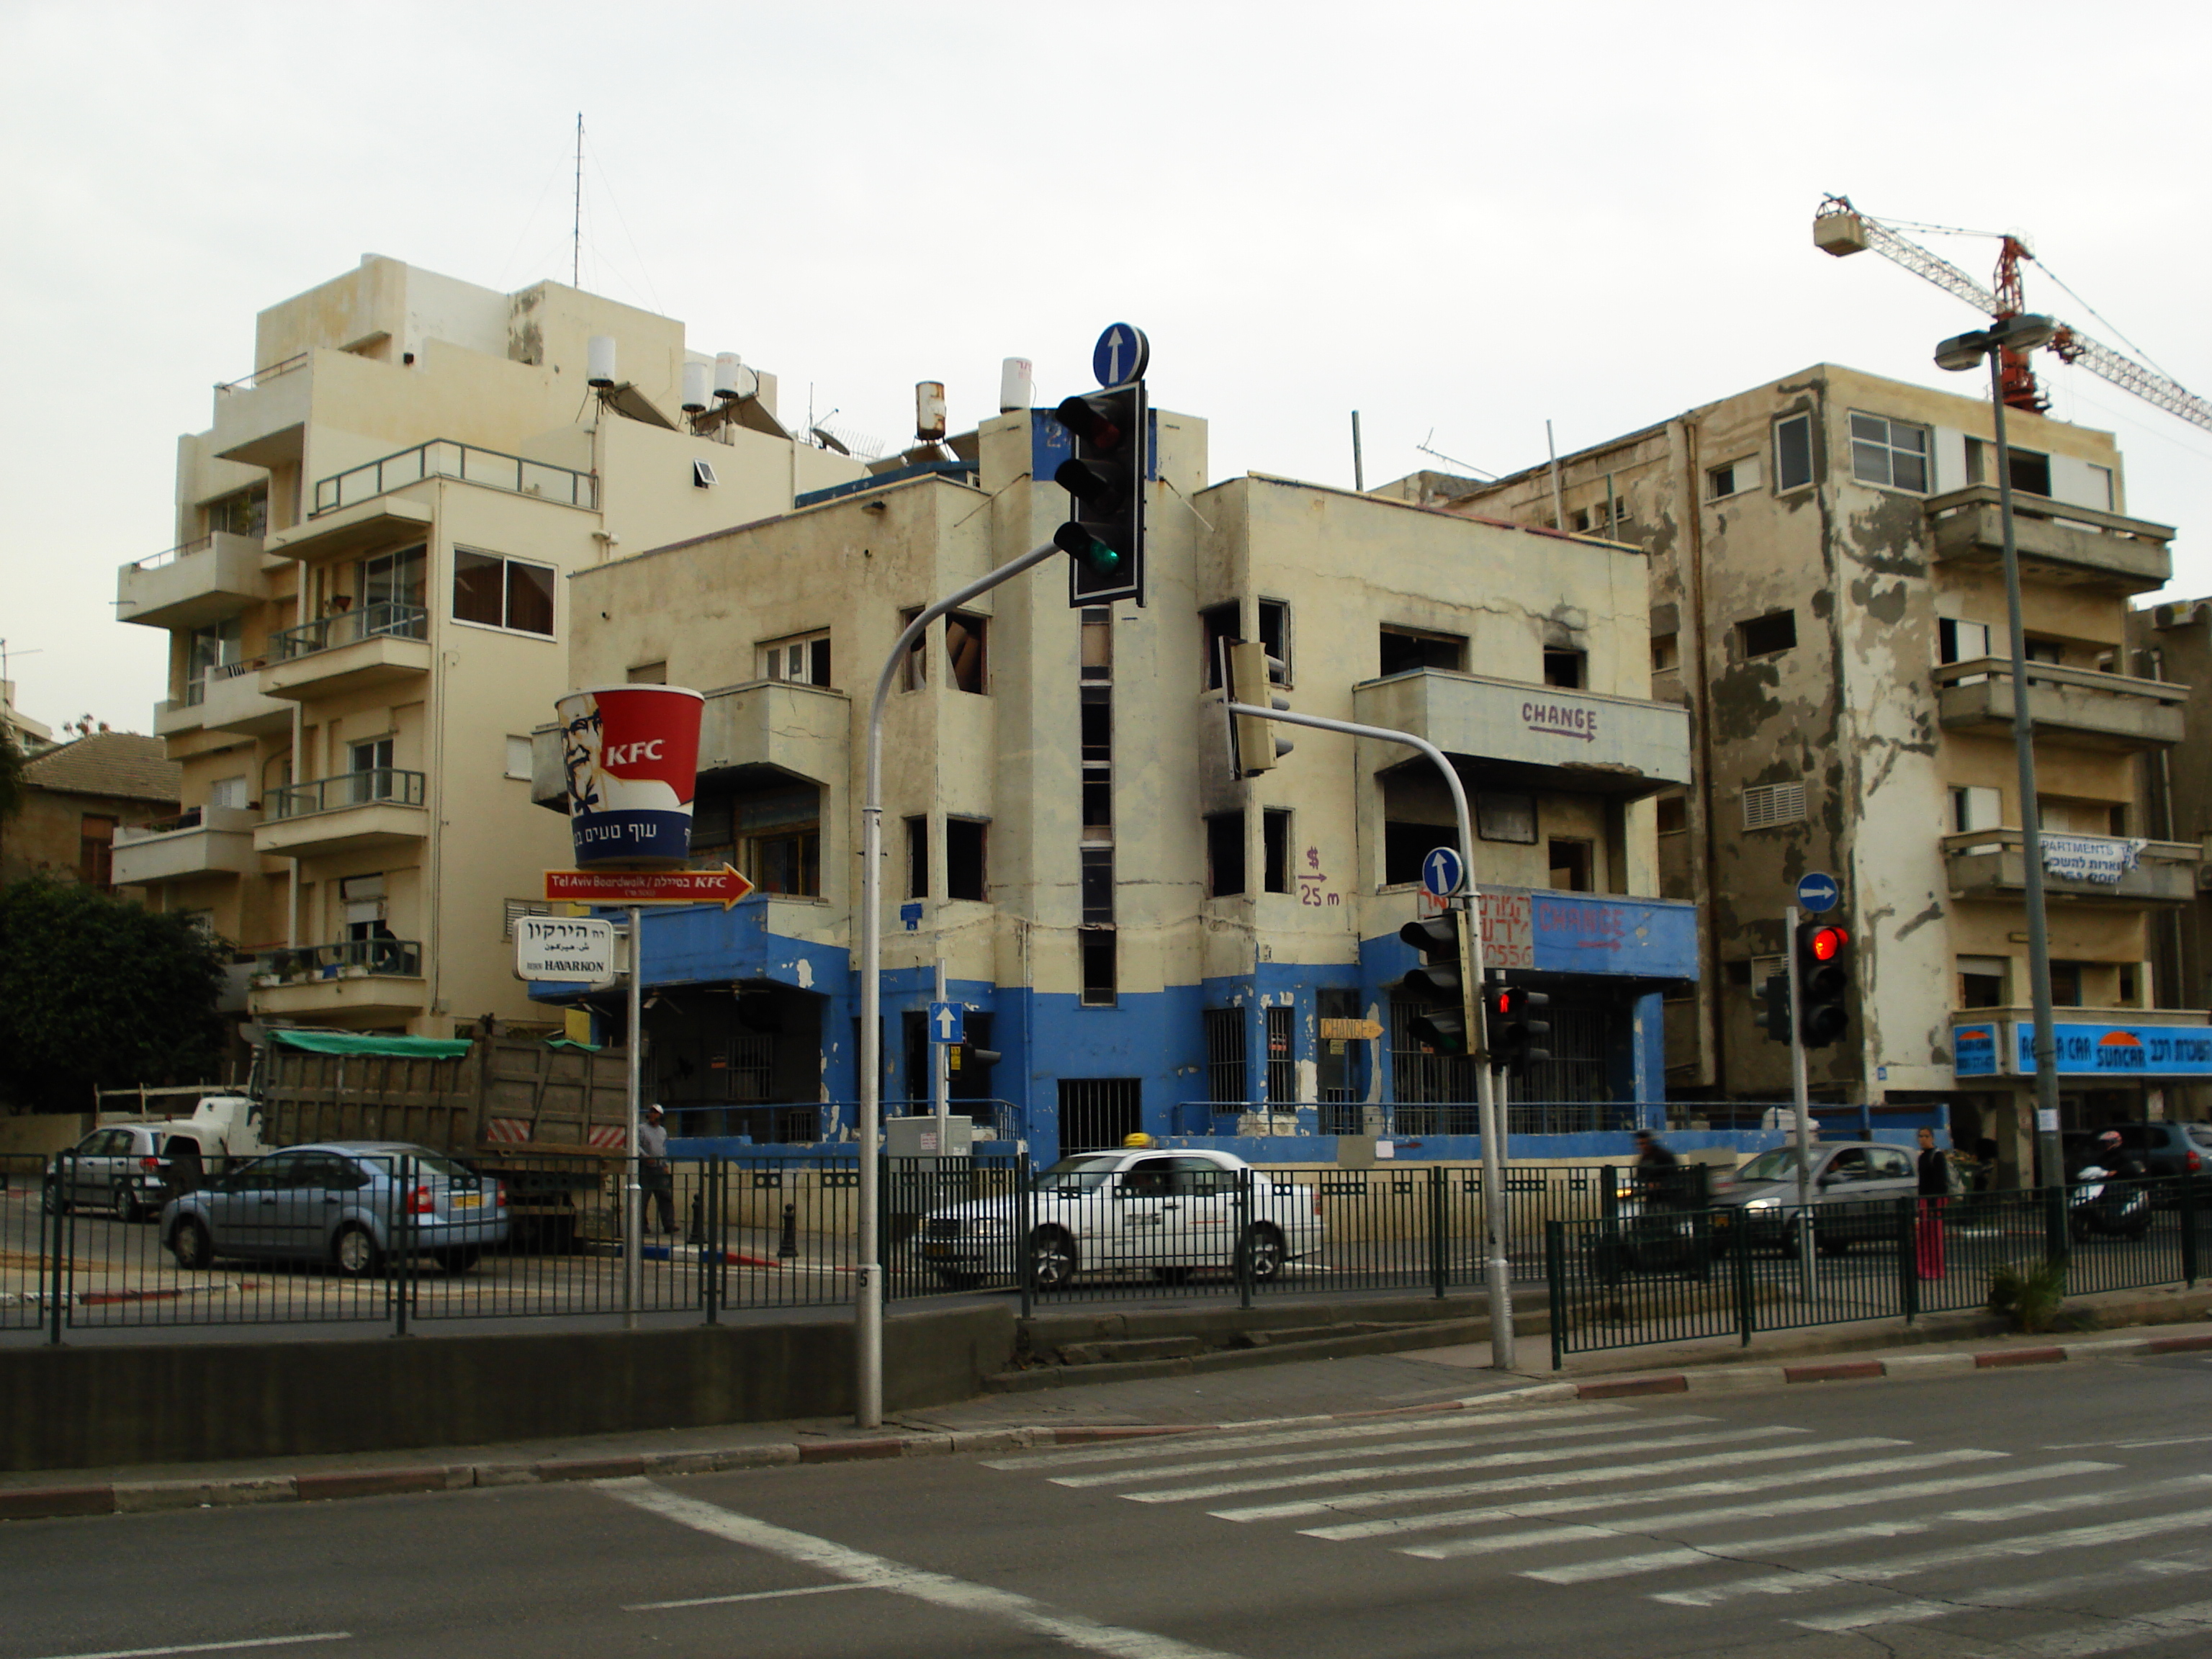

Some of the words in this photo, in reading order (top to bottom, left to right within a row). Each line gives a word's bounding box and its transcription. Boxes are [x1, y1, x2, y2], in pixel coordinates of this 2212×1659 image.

[1522, 702, 1598, 730] CHANGE
[606, 739, 663, 767] KFC
[585, 824, 621, 843] טעים
[629, 824, 657, 842] עוף
[1306, 845, 1319, 870] $
[552, 876, 569, 887] Tel
[570, 876, 592, 887] Aviv
[593, 876, 645, 888] Boardwalk
[694, 876, 727, 889] KFC
[1300, 884, 1322, 907] 25
[1327, 893, 1339, 907] m
[1539, 902, 1626, 937] CHANGE
[528, 922, 588, 940] הירקון
[544, 960, 604, 972] HAYARKON
[1324, 1020, 1368, 1038] CHANGE
[2056, 1036, 2065, 1060] A
[2069, 1036, 2092, 1061] CAR
